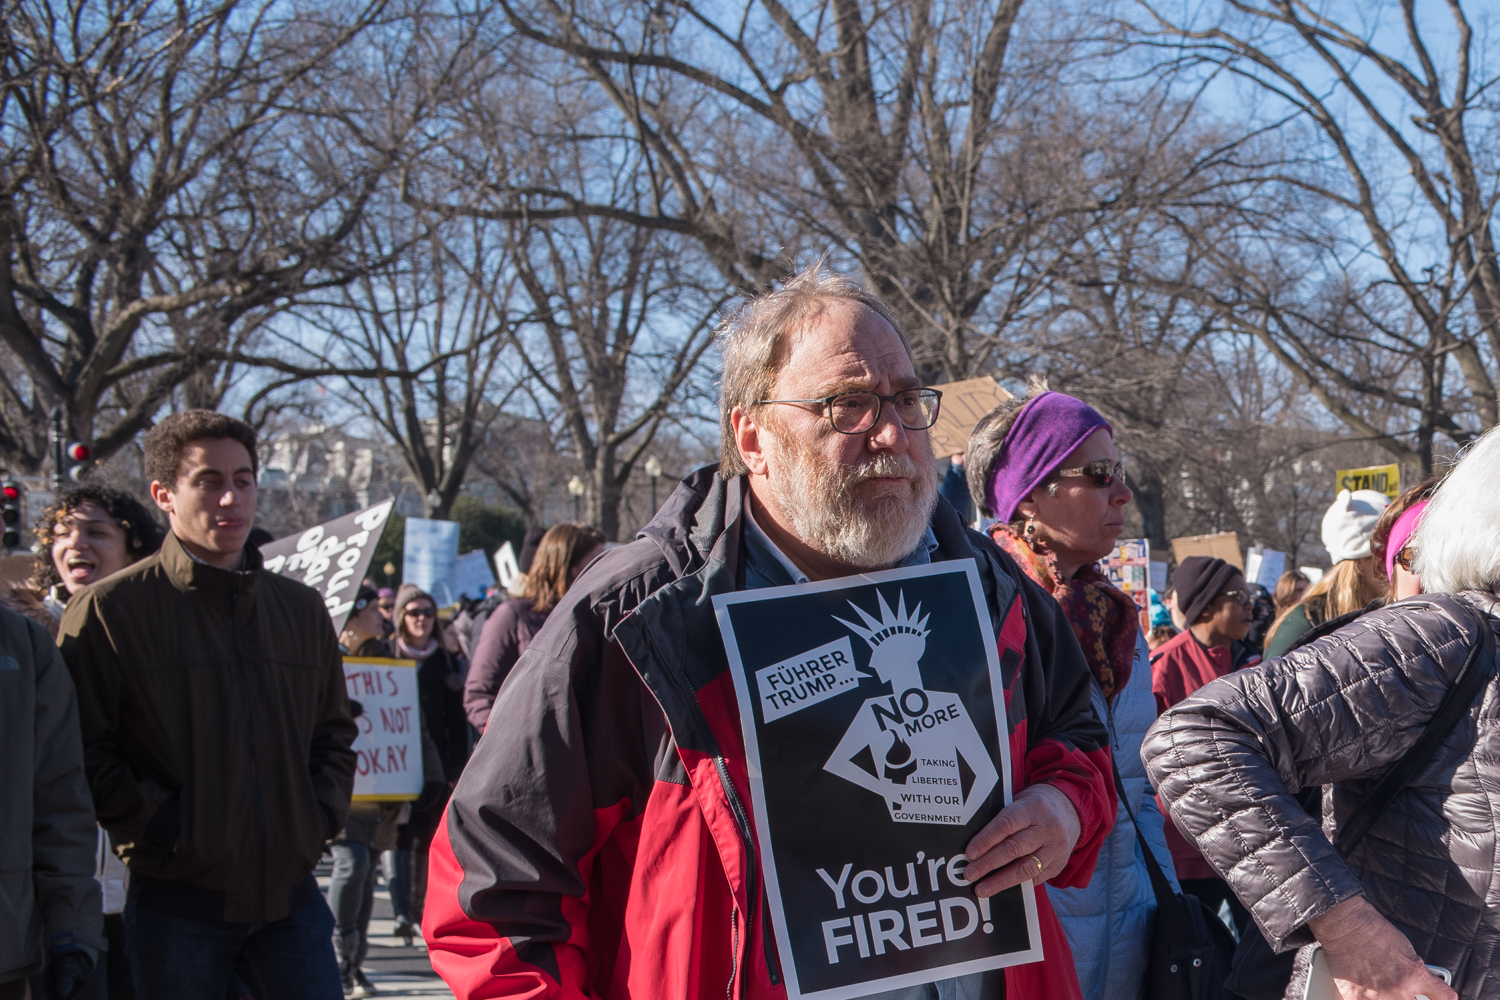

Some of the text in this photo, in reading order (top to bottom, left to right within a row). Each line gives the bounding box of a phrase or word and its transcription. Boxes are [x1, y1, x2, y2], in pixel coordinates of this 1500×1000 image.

[1341, 472, 1388, 493] STAND
[346, 671, 398, 696] THIS
[766, 649, 849, 690] FÜHRER
[765, 673, 854, 710] TRUMP...
[380, 707, 411, 733] NOT
[870, 688, 929, 732] NO
[904, 703, 960, 737] MORE
[356, 745, 407, 776] OKAY
[921, 758, 956, 768] TAKING
[911, 776, 958, 786] LIBERTIES
[900, 793, 960, 805] WITH OUR
[894, 812, 962, 823] GOVERNMENT
[815, 851, 972, 909] You're
[821, 896, 994, 964] FIRED!
